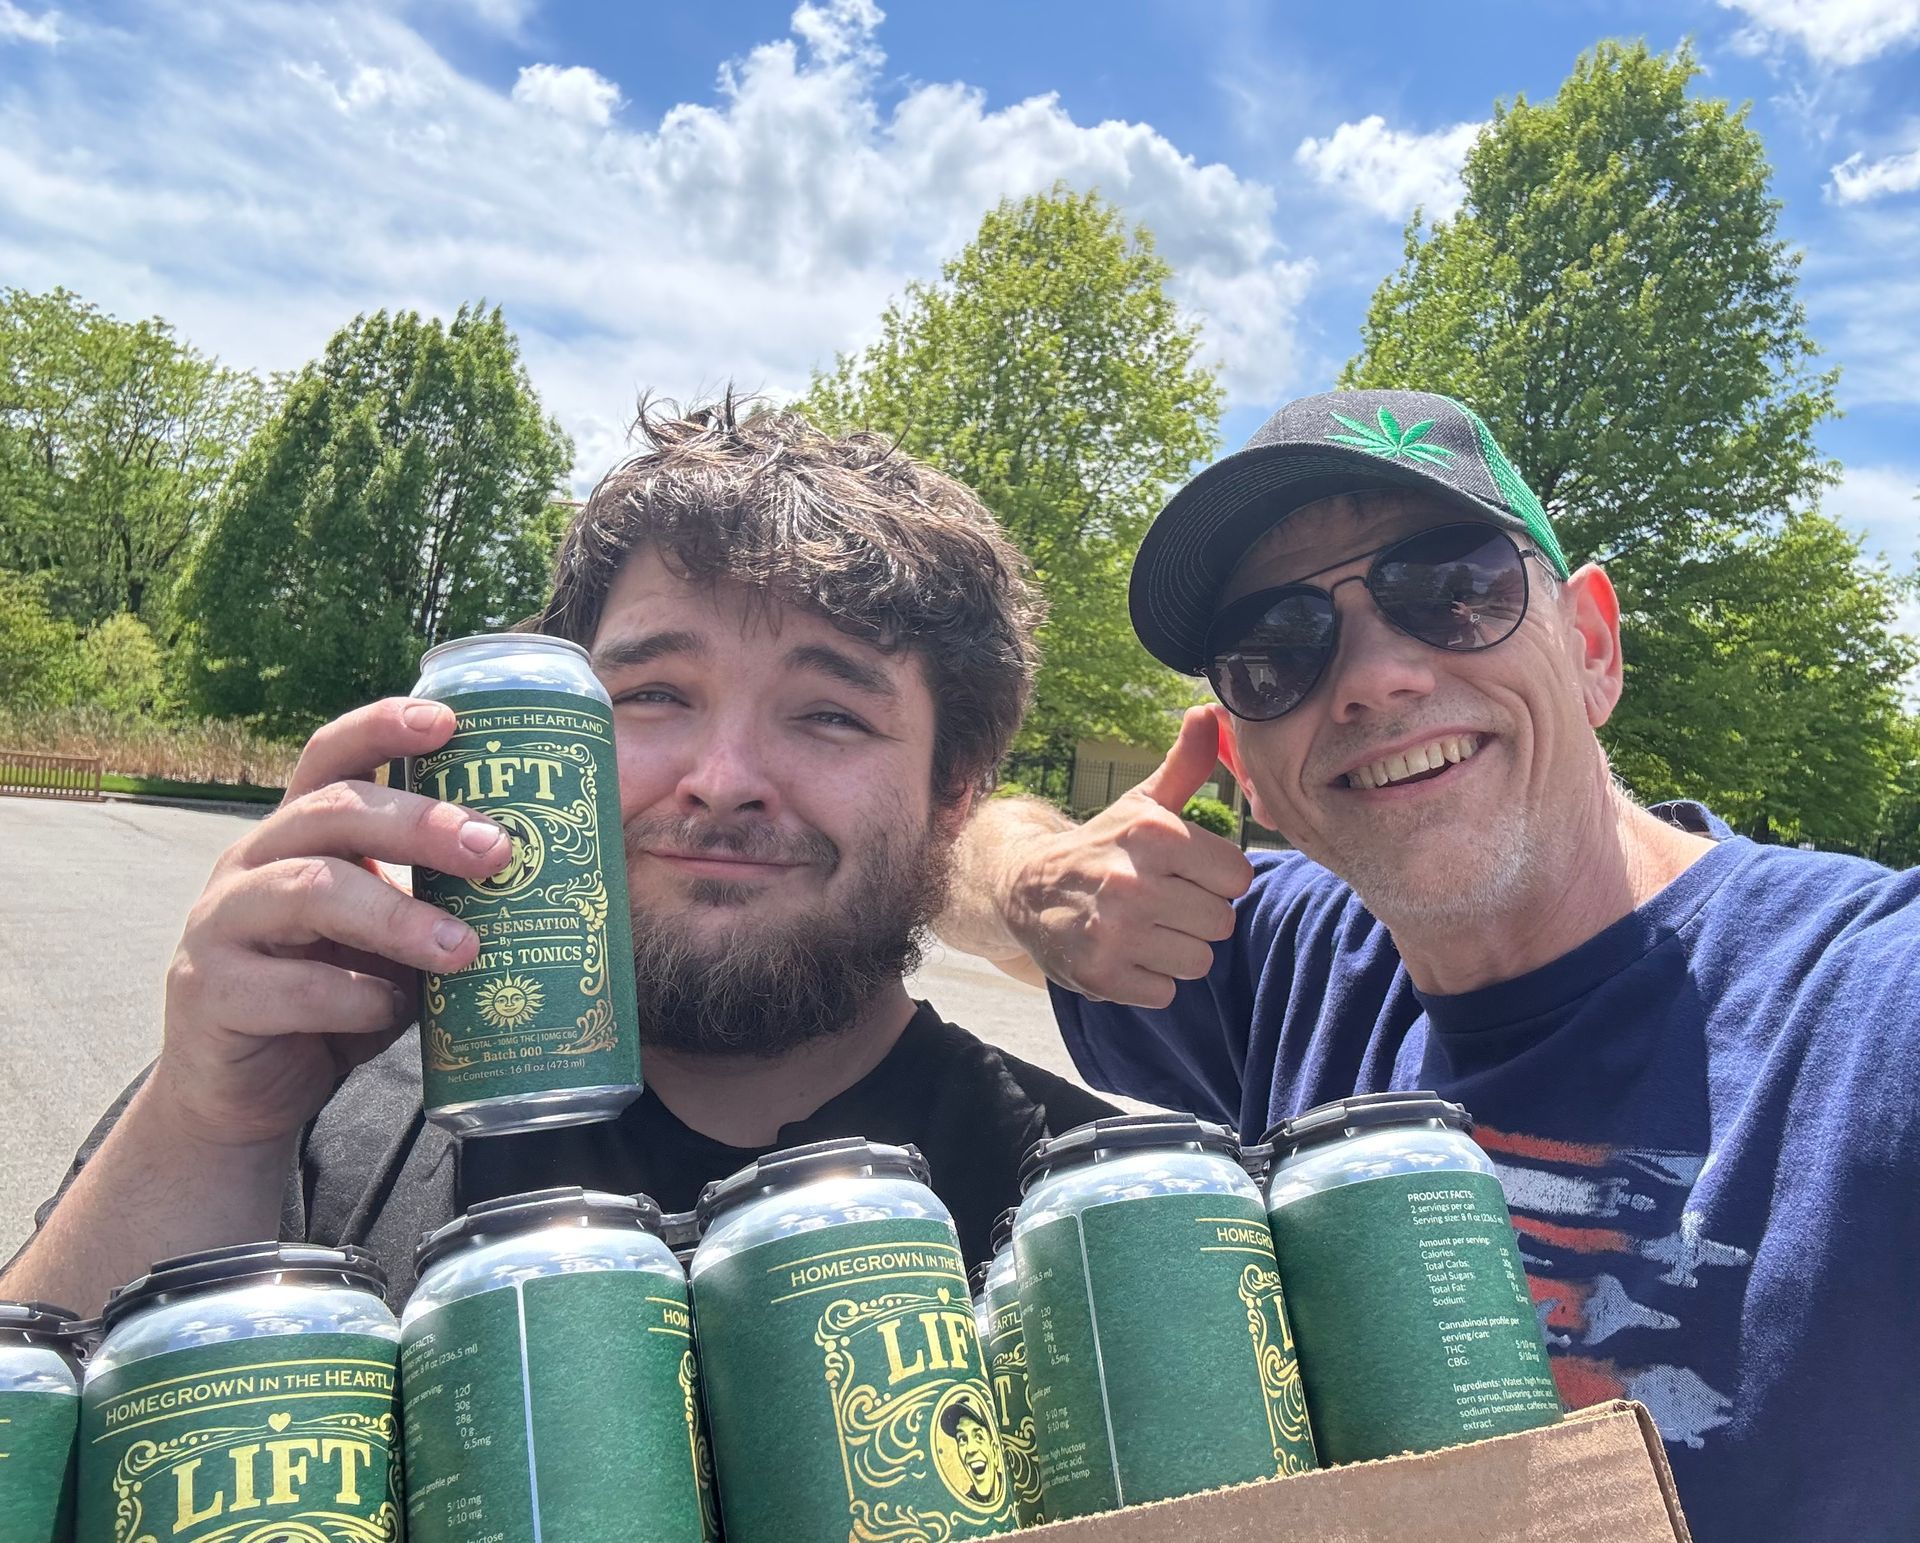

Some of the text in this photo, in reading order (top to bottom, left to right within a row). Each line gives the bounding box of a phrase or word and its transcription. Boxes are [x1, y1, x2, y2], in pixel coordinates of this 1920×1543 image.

[479, 718, 492, 728] IN
[494, 715, 521, 727] THE
[523, 713, 604, 734] HEARTLAND
[434, 756, 564, 804] LIFT
[497, 906, 511, 919] A
[492, 916, 581, 935] SENSATION
[499, 936, 512, 947] By
[444, 946, 582, 976] MY'S TONICS
[471, 1039, 492, 1050] TOTAL
[498, 1036, 519, 1046] 10MG
[563, 1030, 578, 1040] CBG
[482, 1045, 543, 1063] Batch 000
[448, 1058, 586, 1084] Net Contents: 16 fl oz (473 ml)
[1407, 1190, 1475, 1202] PRODUCT FACTS:
[1410, 1205, 1417, 1214] 2
[1418, 1203, 1450, 1213] servings
[1451, 1203, 1463, 1211] per
[1413, 1214, 1444, 1225] Serving
[1444, 1214, 1460, 1222] size:
[1461, 1213, 1467, 1221] 8
[1467, 1212, 1473, 1221] fl
[1419, 1239, 1452, 1248] Amount
[1452, 1237, 1465, 1246] per
[1421, 1249, 1455, 1260] Calories:
[790, 1252, 924, 1288] HOMEGROWN
[926, 1255, 938, 1267] IN
[937, 1255, 956, 1270] THE
[1423, 1261, 1445, 1271] Total
[1445, 1259, 1470, 1269] Carbs:
[1426, 1273, 1447, 1283] Total
[1448, 1271, 1476, 1282] Sugars:
[1429, 1285, 1450, 1295] Total
[1451, 1283, 1467, 1292] Fat:
[1432, 1296, 1466, 1307] Sodium:
[1438, 1315, 1520, 1330] Cannabinoid profile per
[439, 1347, 463, 1366] (236.5
[464, 1343, 479, 1356] ml)
[1443, 1344, 1467, 1355] THC:
[1447, 1356, 1471, 1368] CBG:
[454, 1383, 471, 1399] 120
[1453, 1379, 1501, 1393] Ingredients:
[105, 1376, 255, 1427] HOMEGROWN
[259, 1376, 279, 1392] IN
[284, 1373, 321, 1388] THE
[325, 1369, 395, 1391] HEARTL
[1456, 1396, 1476, 1406] corn
[454, 1400, 471, 1412] 30g
[1459, 1406, 1491, 1418] sodium
[455, 1414, 473, 1426] 28g
[1462, 1419, 1495, 1431] extract.
[463, 1435, 492, 1450] 6.5mg
[1061, 1442, 1086, 1455] fructose
[446, 1473, 460, 1486] per
[1071, 1468, 1091, 1480] hemp
[171, 1437, 371, 1535] LIFT
[468, 1494, 482, 1506] mg
[468, 1509, 483, 1521] mg
